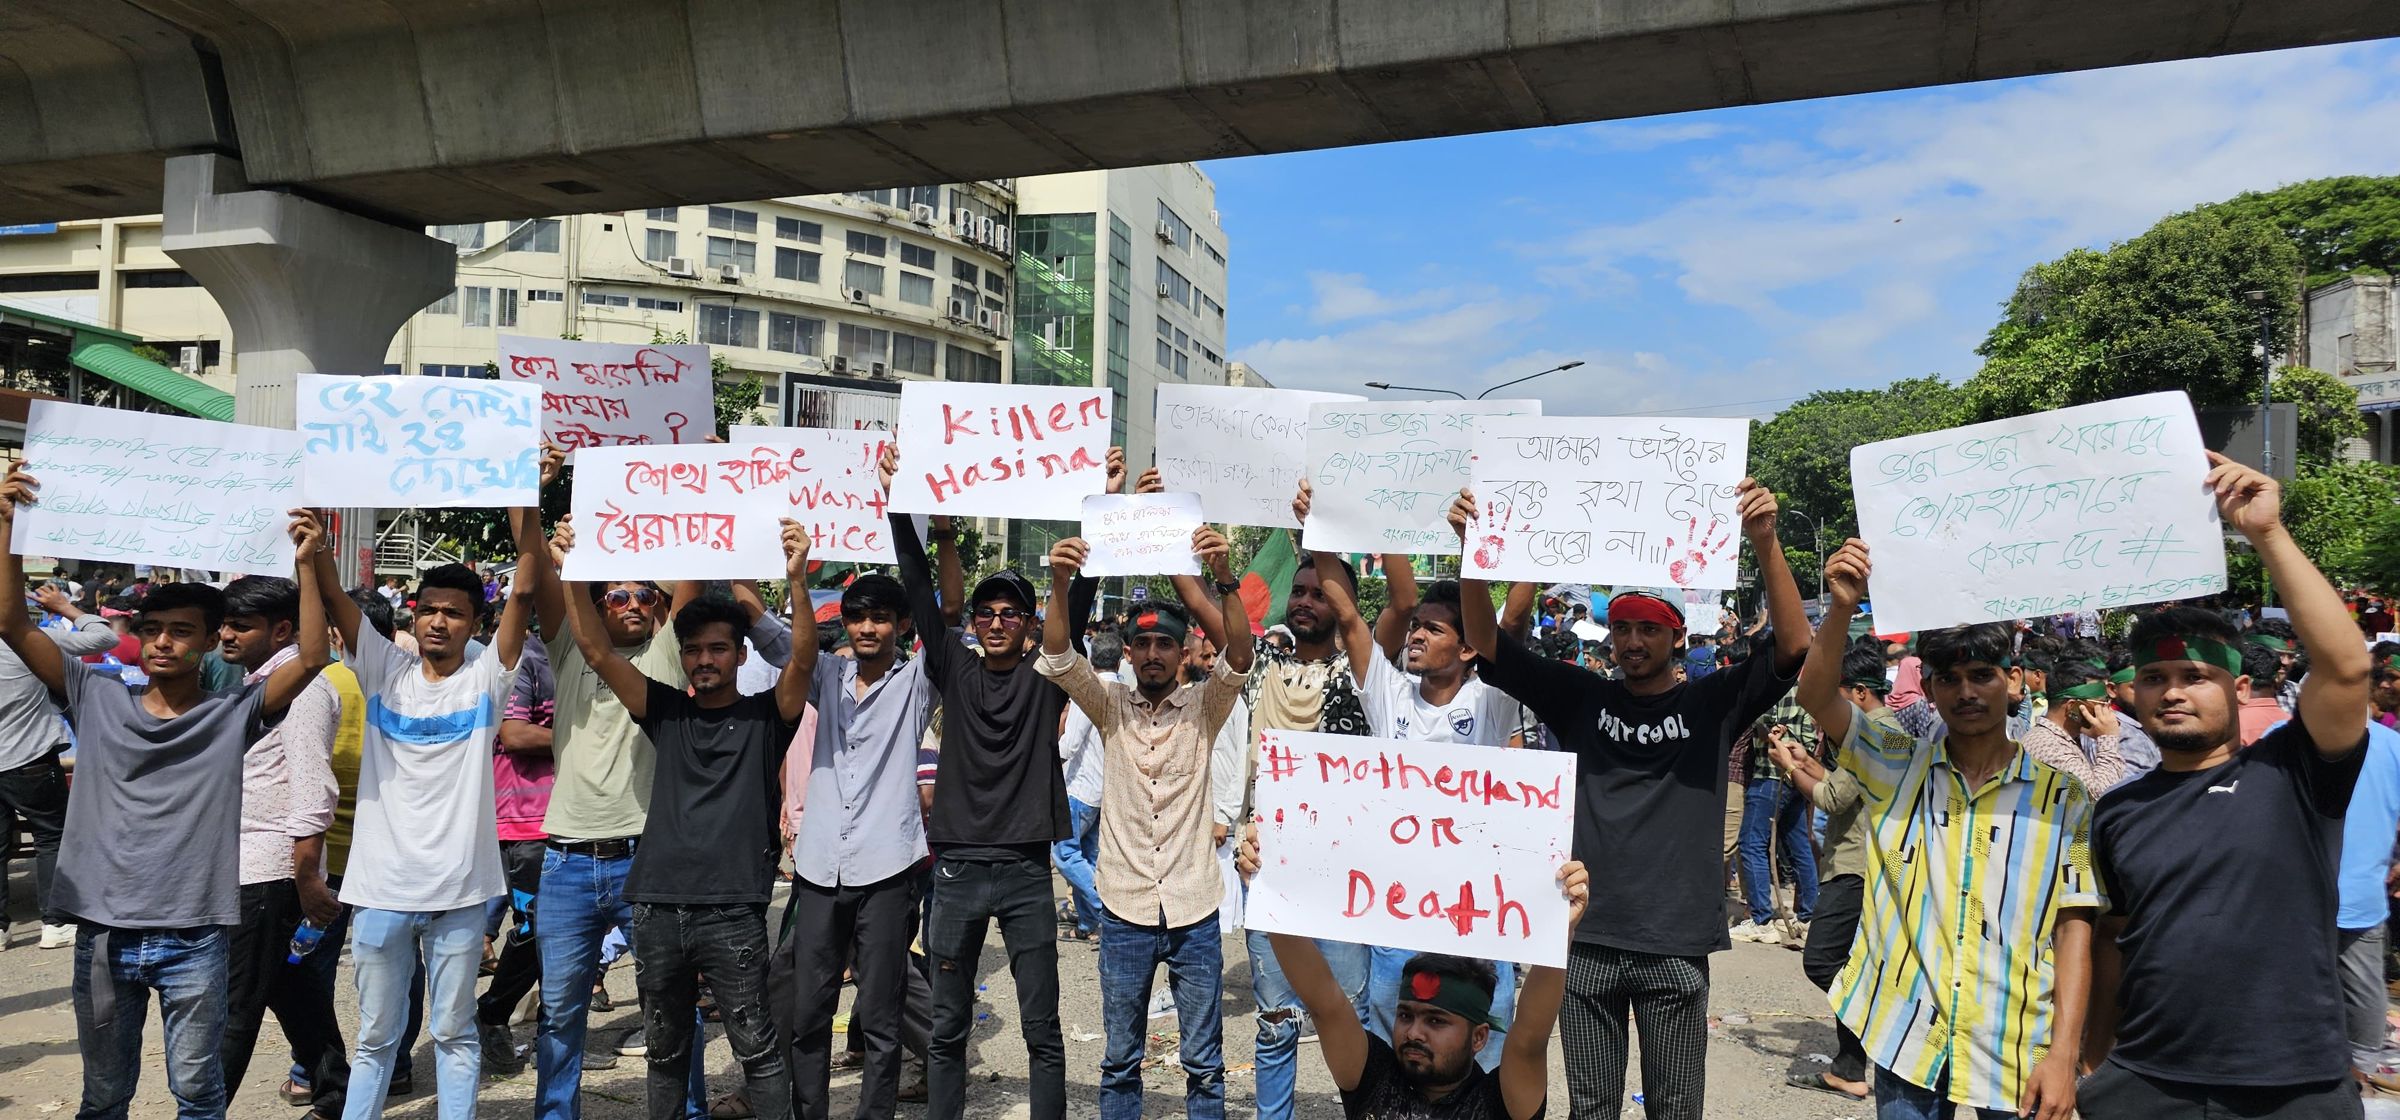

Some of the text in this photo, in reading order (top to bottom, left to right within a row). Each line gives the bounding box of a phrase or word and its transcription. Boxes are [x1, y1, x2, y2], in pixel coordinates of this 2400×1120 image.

[942, 396, 1108, 445] Killer
[1497, 435, 1601, 466] আমার
[925, 446, 1103, 503] Hasina
[789, 478, 889, 520] Want
[1636, 713, 1691, 745] COOL
[1341, 868, 1532, 939] Death
